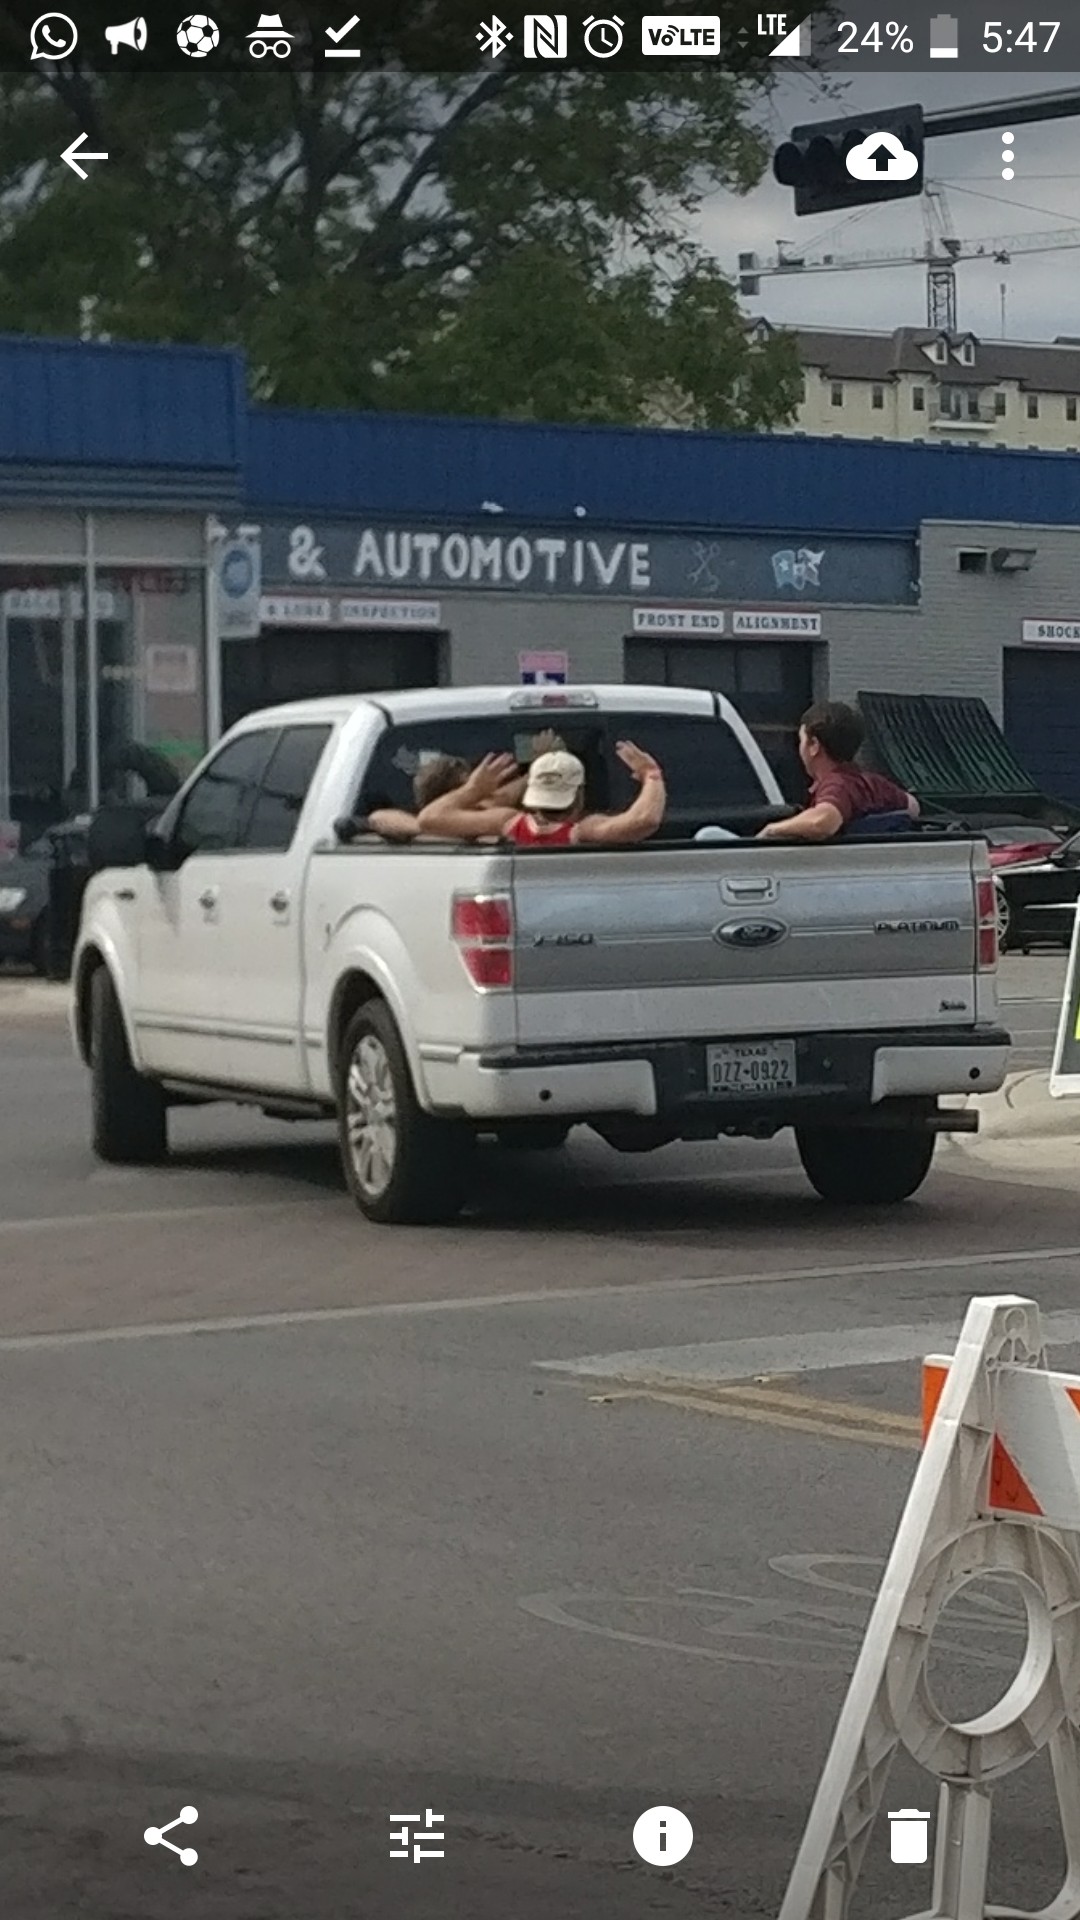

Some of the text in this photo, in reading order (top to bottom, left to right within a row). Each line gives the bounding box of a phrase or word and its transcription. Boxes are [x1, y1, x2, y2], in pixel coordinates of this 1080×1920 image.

[288, 524, 328, 580] &
[353, 527, 652, 588] AUTOMOTIVE
[343, 604, 438, 619] INSPECTION
[637, 612, 721, 629] FRONT END
[736, 615, 818, 632] ALIGNMENT
[876, 919, 961, 934] PLATINUM
[734, 1046, 769, 1058] TEXAS
